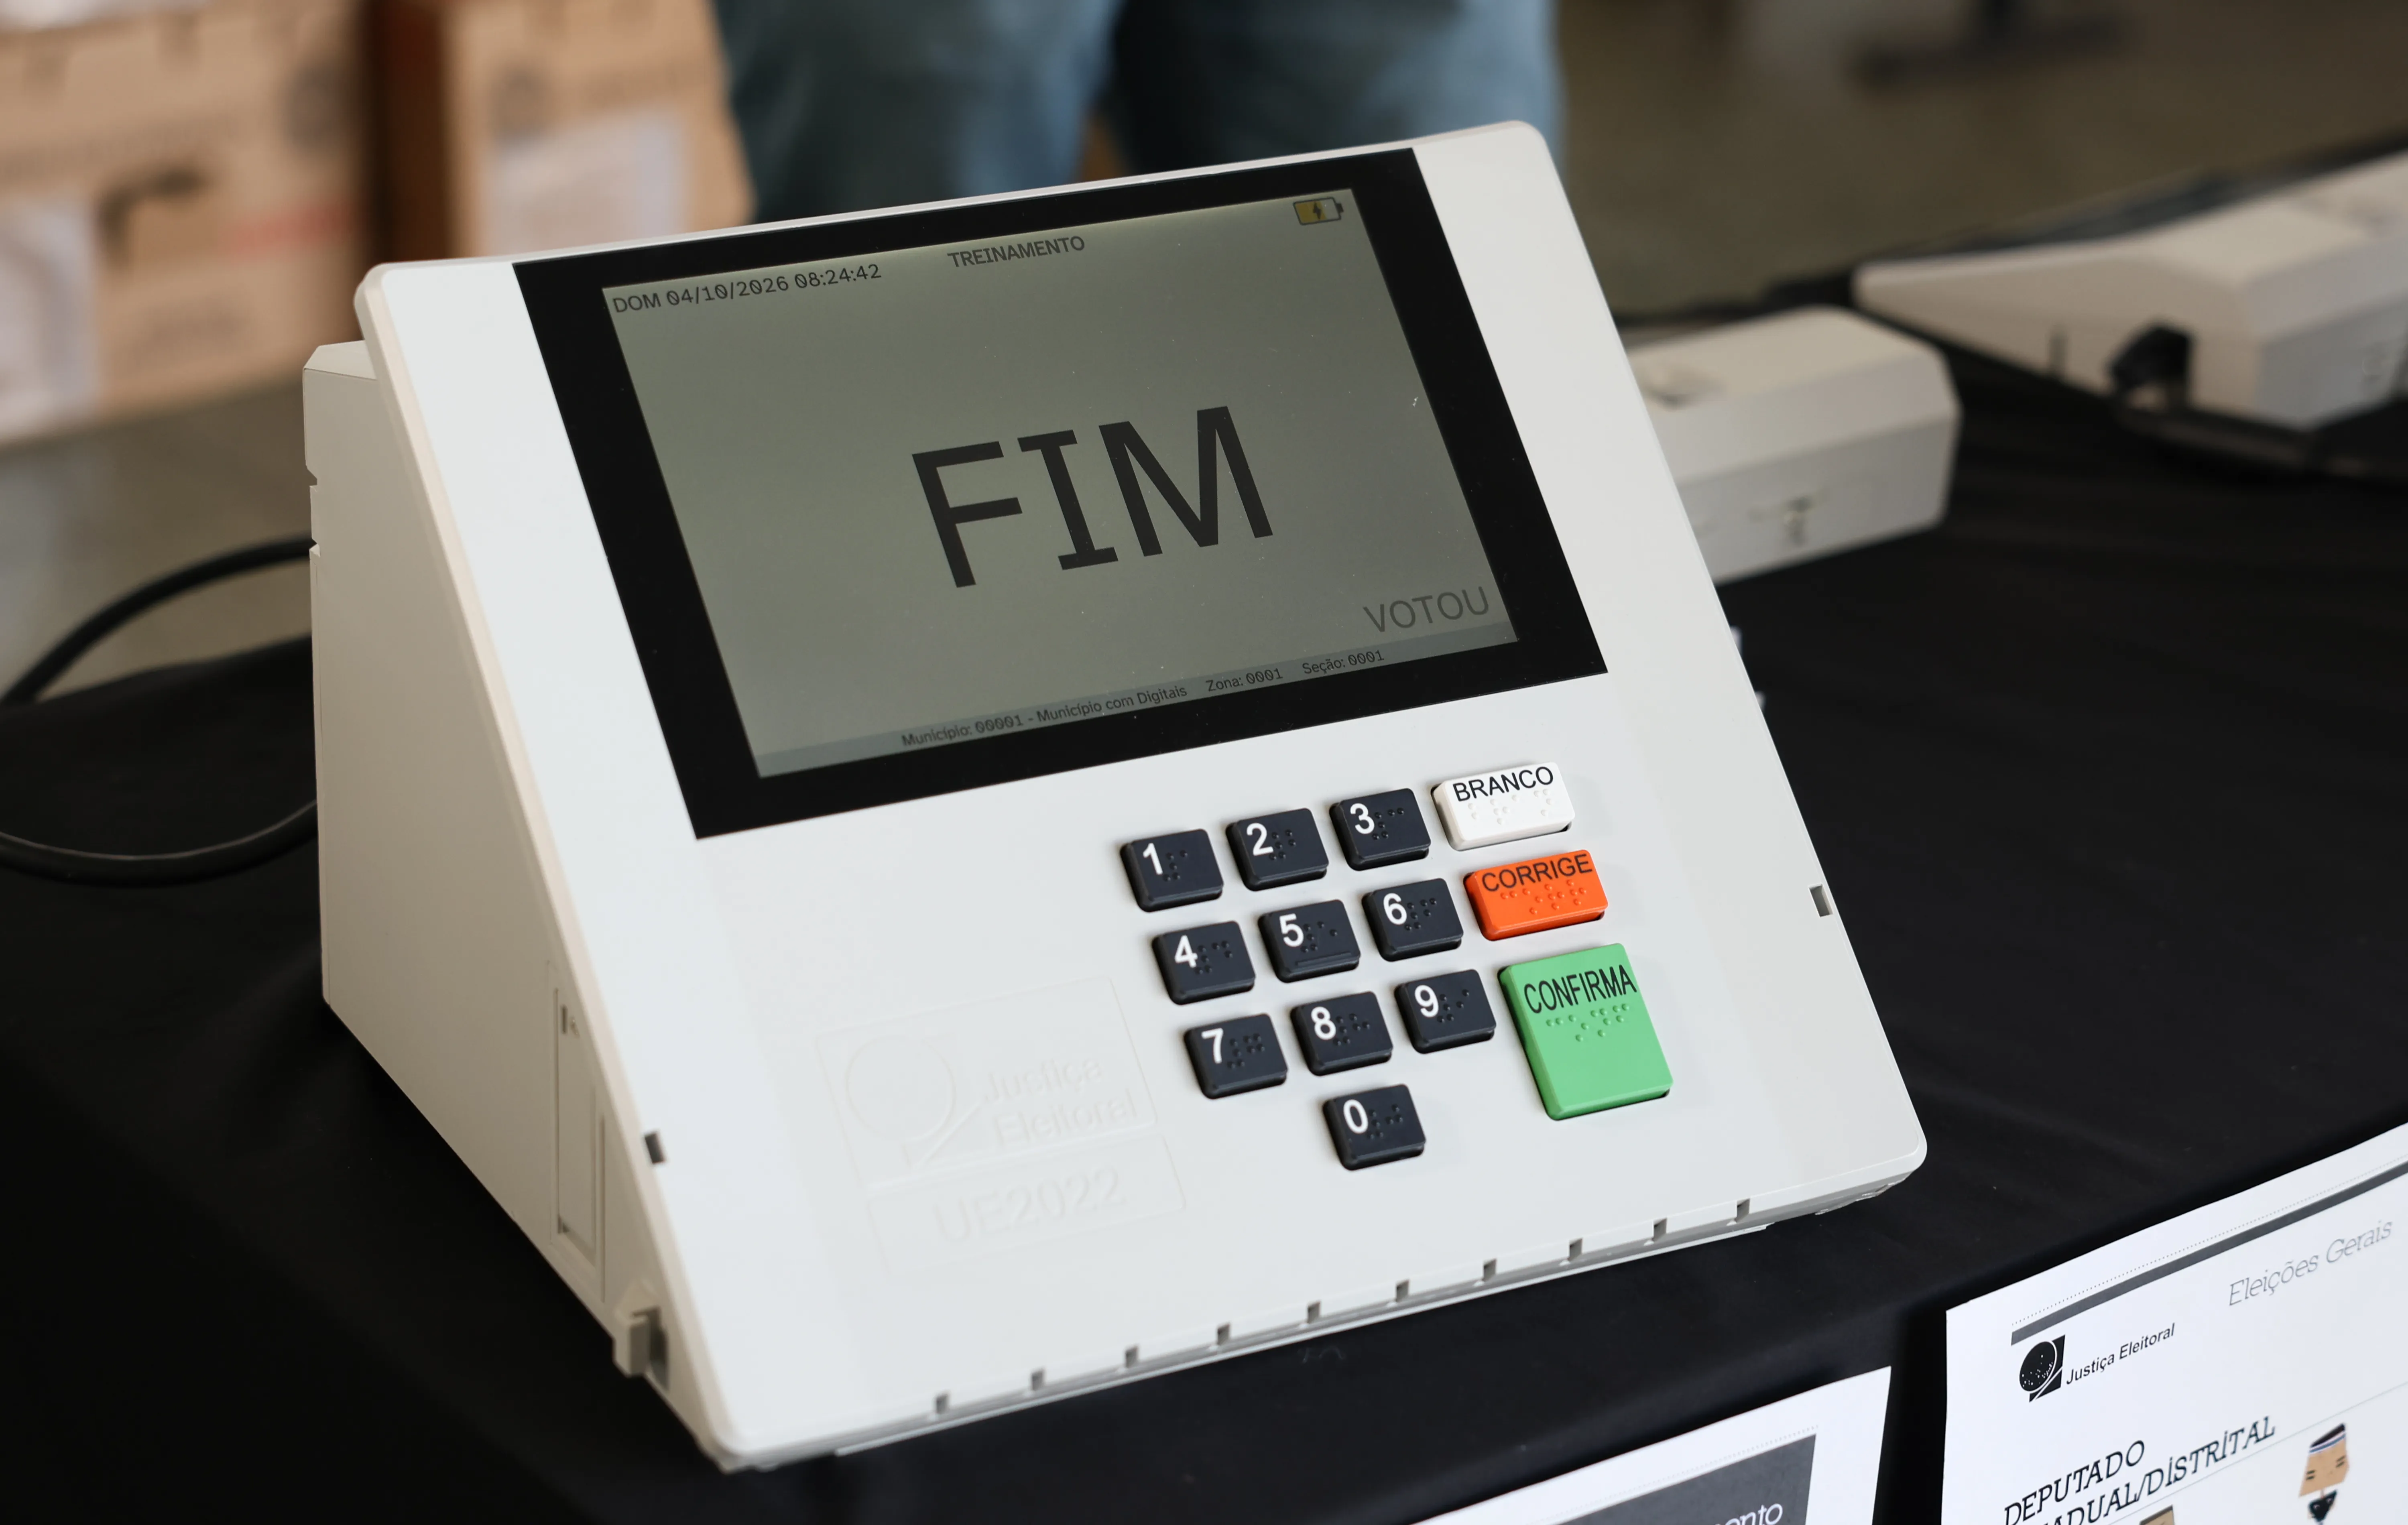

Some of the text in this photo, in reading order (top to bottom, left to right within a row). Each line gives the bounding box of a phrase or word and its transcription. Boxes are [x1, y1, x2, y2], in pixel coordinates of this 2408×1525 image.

[947, 236, 1085, 267] TREINAMENTO
[613, 264, 881, 313] DOM 04/10/2026 08:24:42
[912, 406, 1273, 588] FIM
[1363, 586, 1489, 632] VOTOU
[902, 725, 973, 747] Município:
[974, 714, 1024, 734] 00001
[1036, 702, 1102, 723] Município
[1106, 697, 1135, 710] com
[1137, 685, 1188, 706] Digitais
[1206, 677, 1244, 692] Zona:
[1245, 668, 1283, 685] 0001
[1302, 658, 1346, 675] Seção:
[1347, 650, 1384, 666] 0001
[1452, 766, 1554, 801] BRANCO
[1350, 803, 1375, 834] 3
[1246, 823, 1273, 856] 2
[1143, 842, 1163, 875] 1
[1481, 854, 1592, 892] CORRIGE
[1383, 893, 1407, 925] 6
[1279, 913, 1304, 947] 5
[1174, 935, 1198, 968] 4
[1414, 984, 1439, 1018] 9
[1524, 964, 1637, 1014] CONFIRMA
[1311, 1007, 1336, 1040] 8
[1202, 1028, 1224, 1063] 7
[983, 1057, 1103, 1104] Justiça
[992, 1087, 1139, 1148] Eleitoral
[1343, 1099, 1369, 1134] 0
[933, 1165, 1127, 1243] UE2022
[2229, 1220, 2392, 1306] Eleições Gerais
[2066, 1322, 2175, 1385] Justiça Eleitoral
[2005, 1440, 2144, 1525] DEPUTADO
